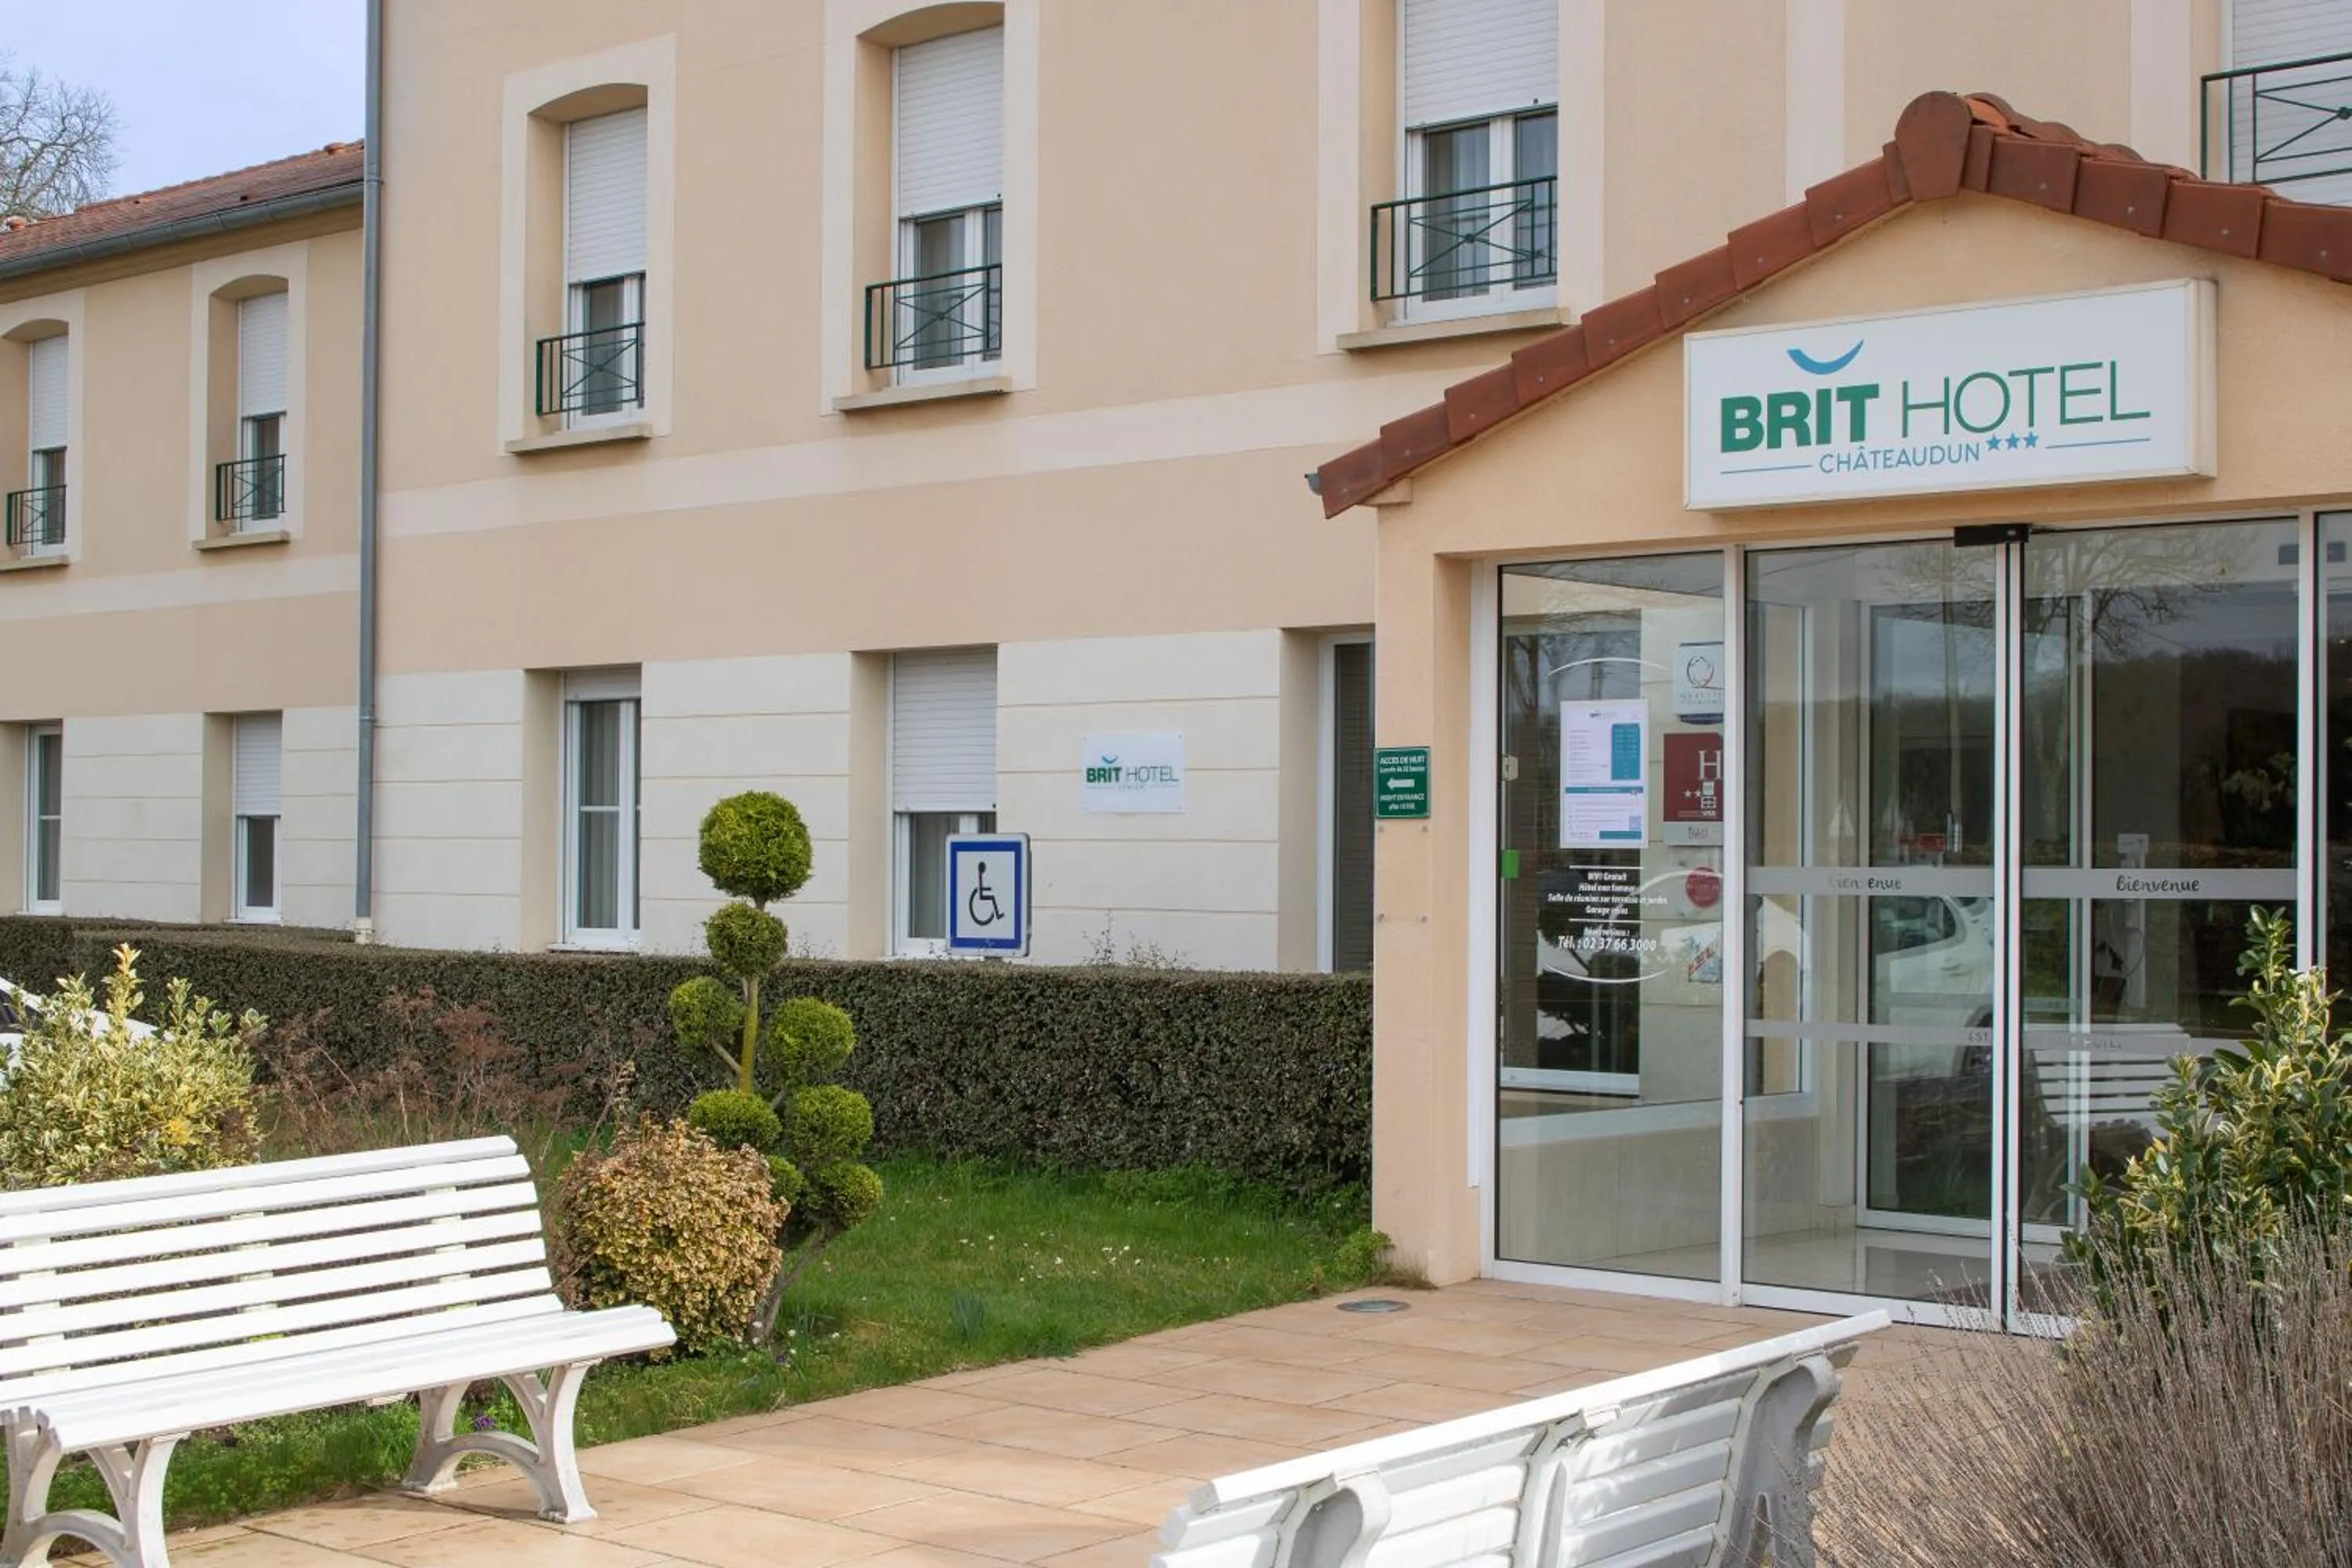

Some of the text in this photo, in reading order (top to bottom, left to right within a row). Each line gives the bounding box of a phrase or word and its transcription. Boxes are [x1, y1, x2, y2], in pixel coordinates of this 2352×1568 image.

[1720, 360, 2151, 453] BRIT HOTEL
[1818, 441, 1980, 475] CHÂTEAUDUN
[1086, 765, 1179, 783] BRIT HOTEL
[2116, 874, 2203, 893] Bienvenue
